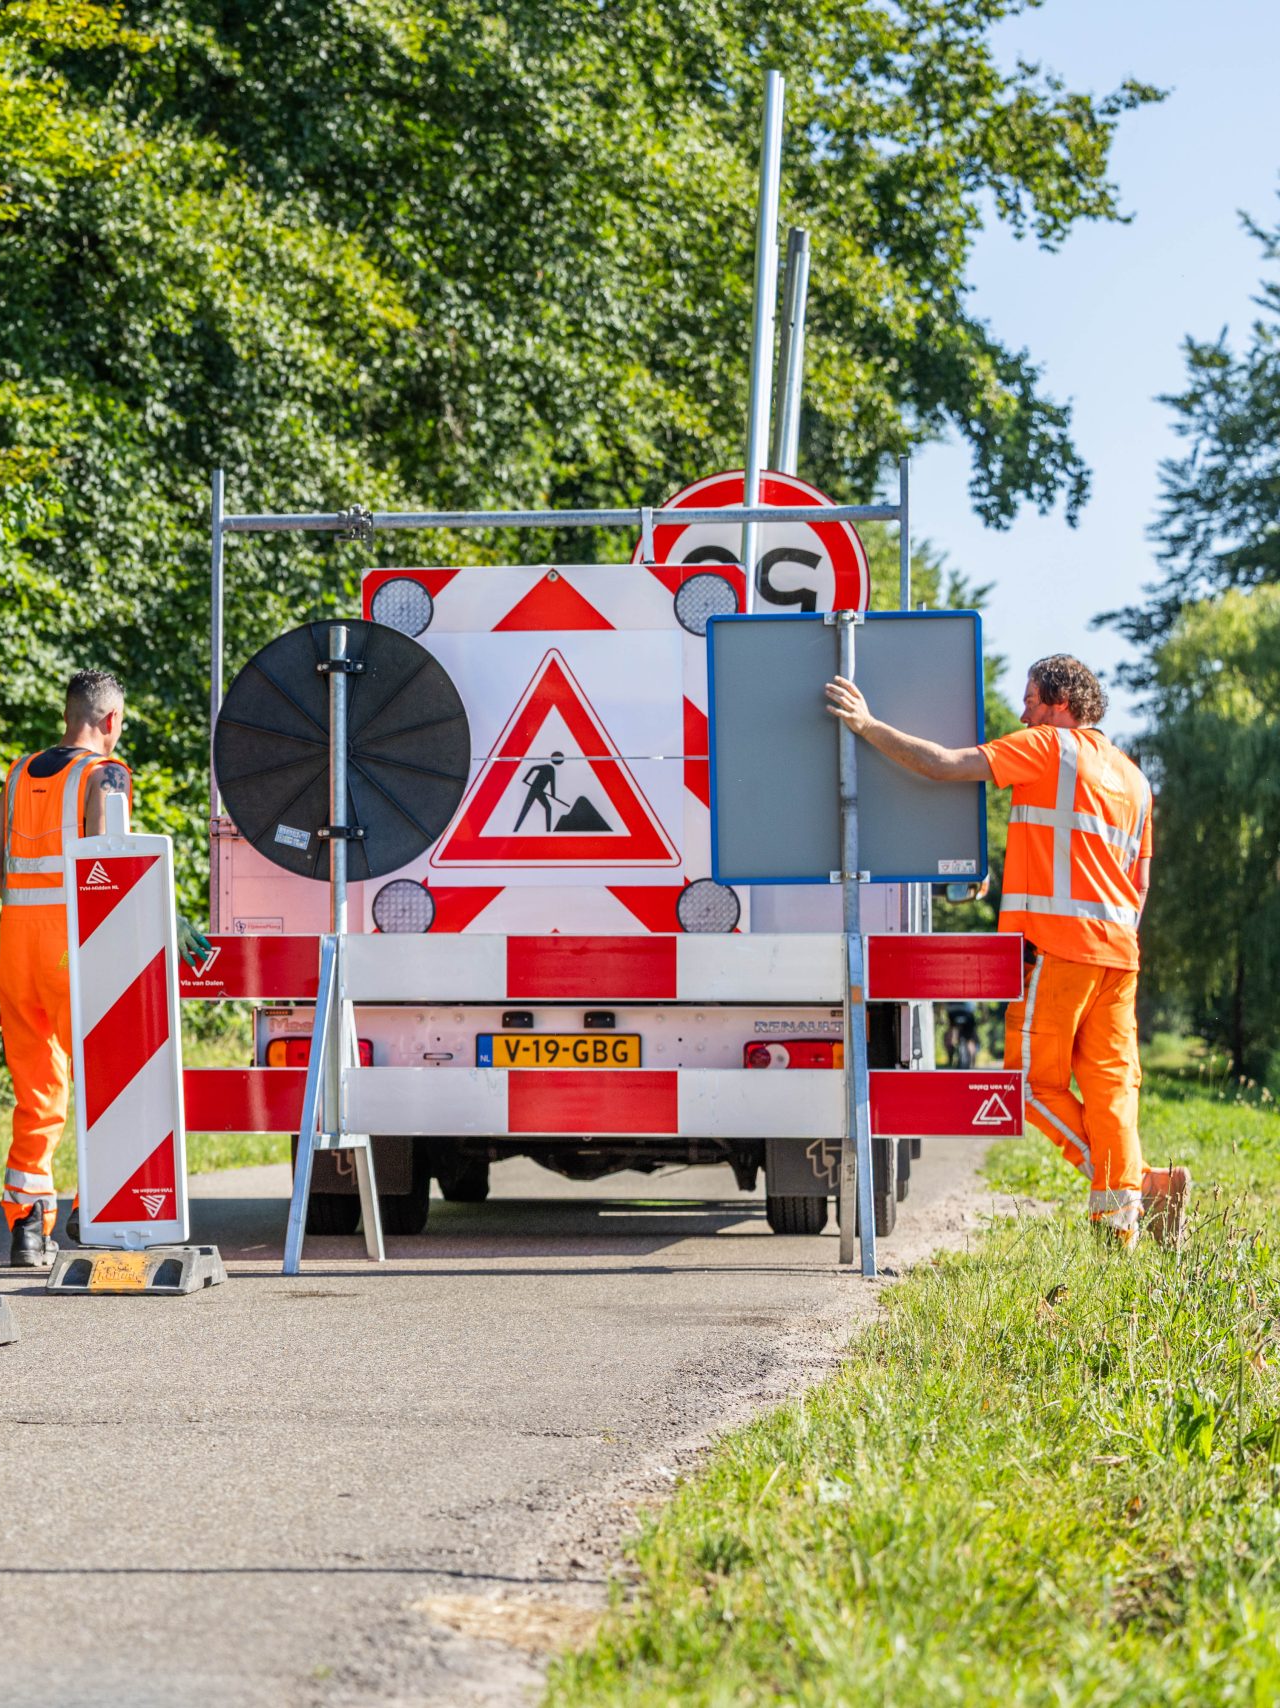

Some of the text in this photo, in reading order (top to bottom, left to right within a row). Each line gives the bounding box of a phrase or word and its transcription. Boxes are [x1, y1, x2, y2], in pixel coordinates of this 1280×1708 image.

[754, 1020, 844, 1033] RENAULT
[504, 1039, 629, 1064] V-19-GBG
[480, 1055, 491, 1063] NL
